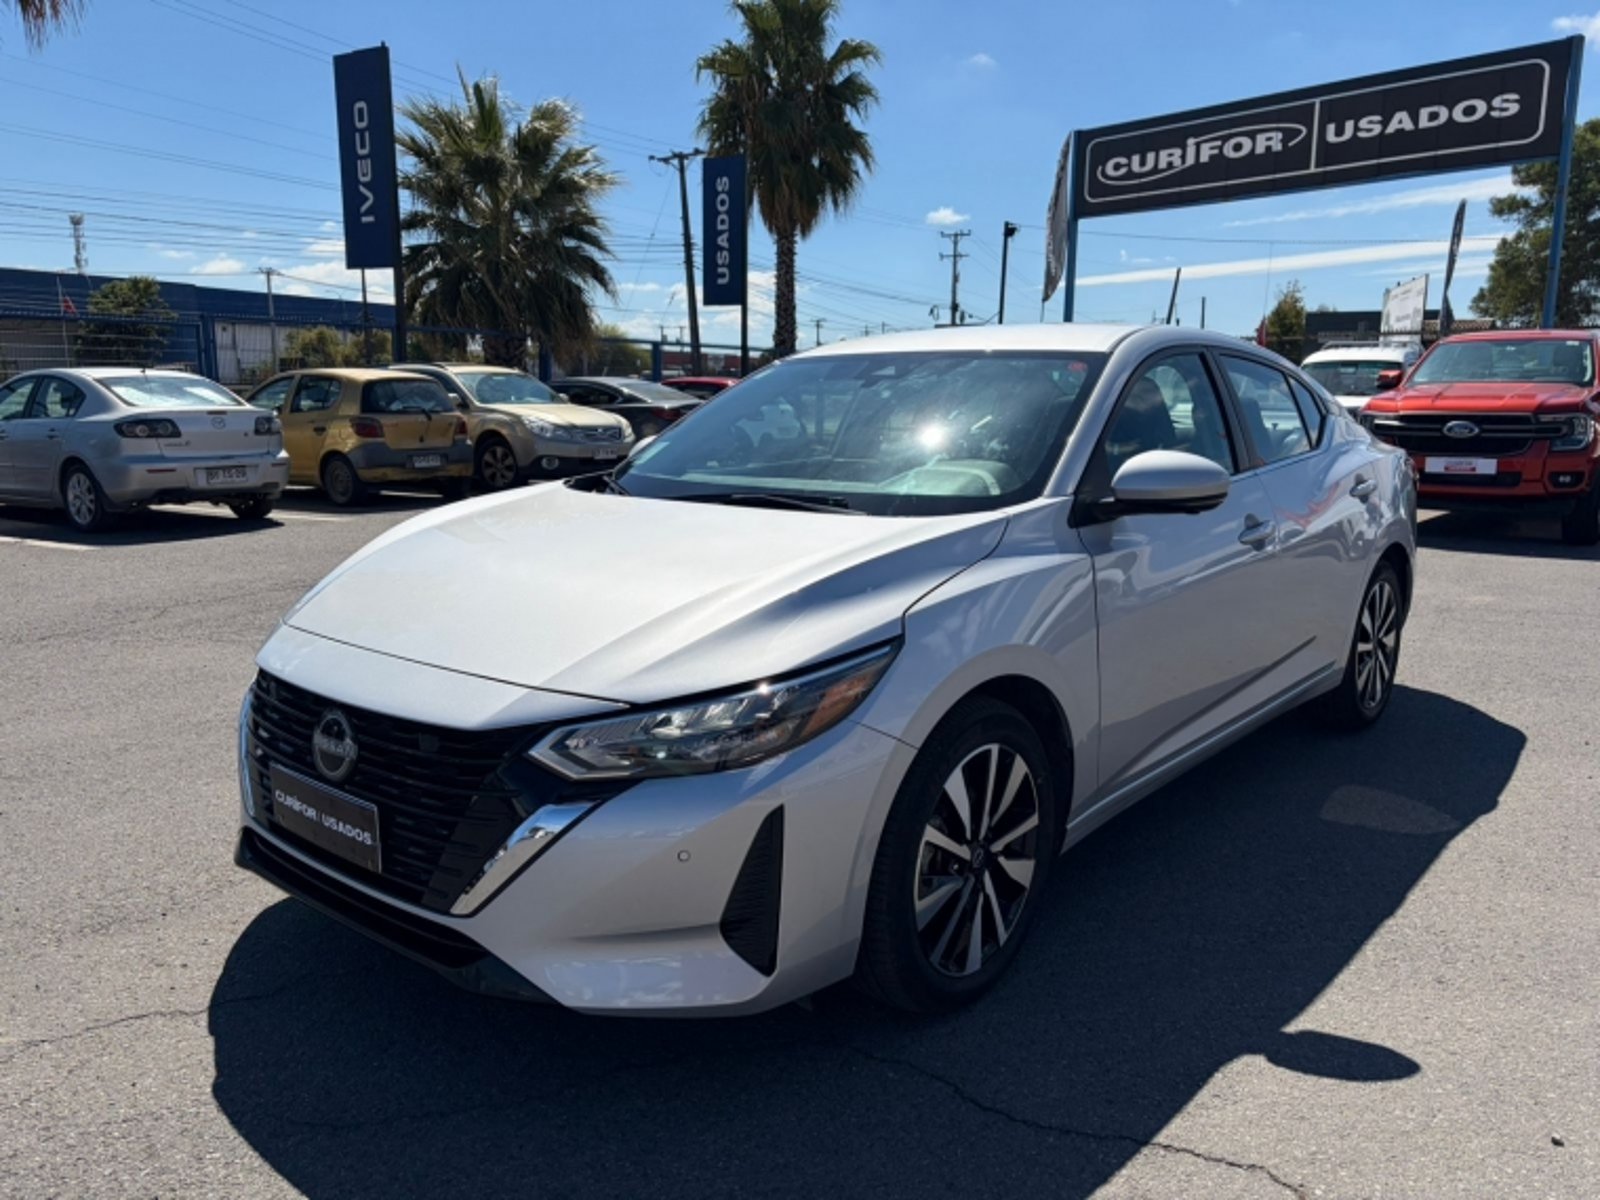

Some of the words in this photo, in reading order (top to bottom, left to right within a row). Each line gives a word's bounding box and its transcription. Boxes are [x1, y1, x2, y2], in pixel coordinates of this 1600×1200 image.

[353, 100, 375, 224] IVECO
[1103, 131, 1284, 179] CURIFOR
[1325, 93, 1522, 145] USADOS
[716, 175, 730, 285] USADOS
[275, 789, 317, 821] CURIFOR
[321, 814, 373, 846] USADOS
